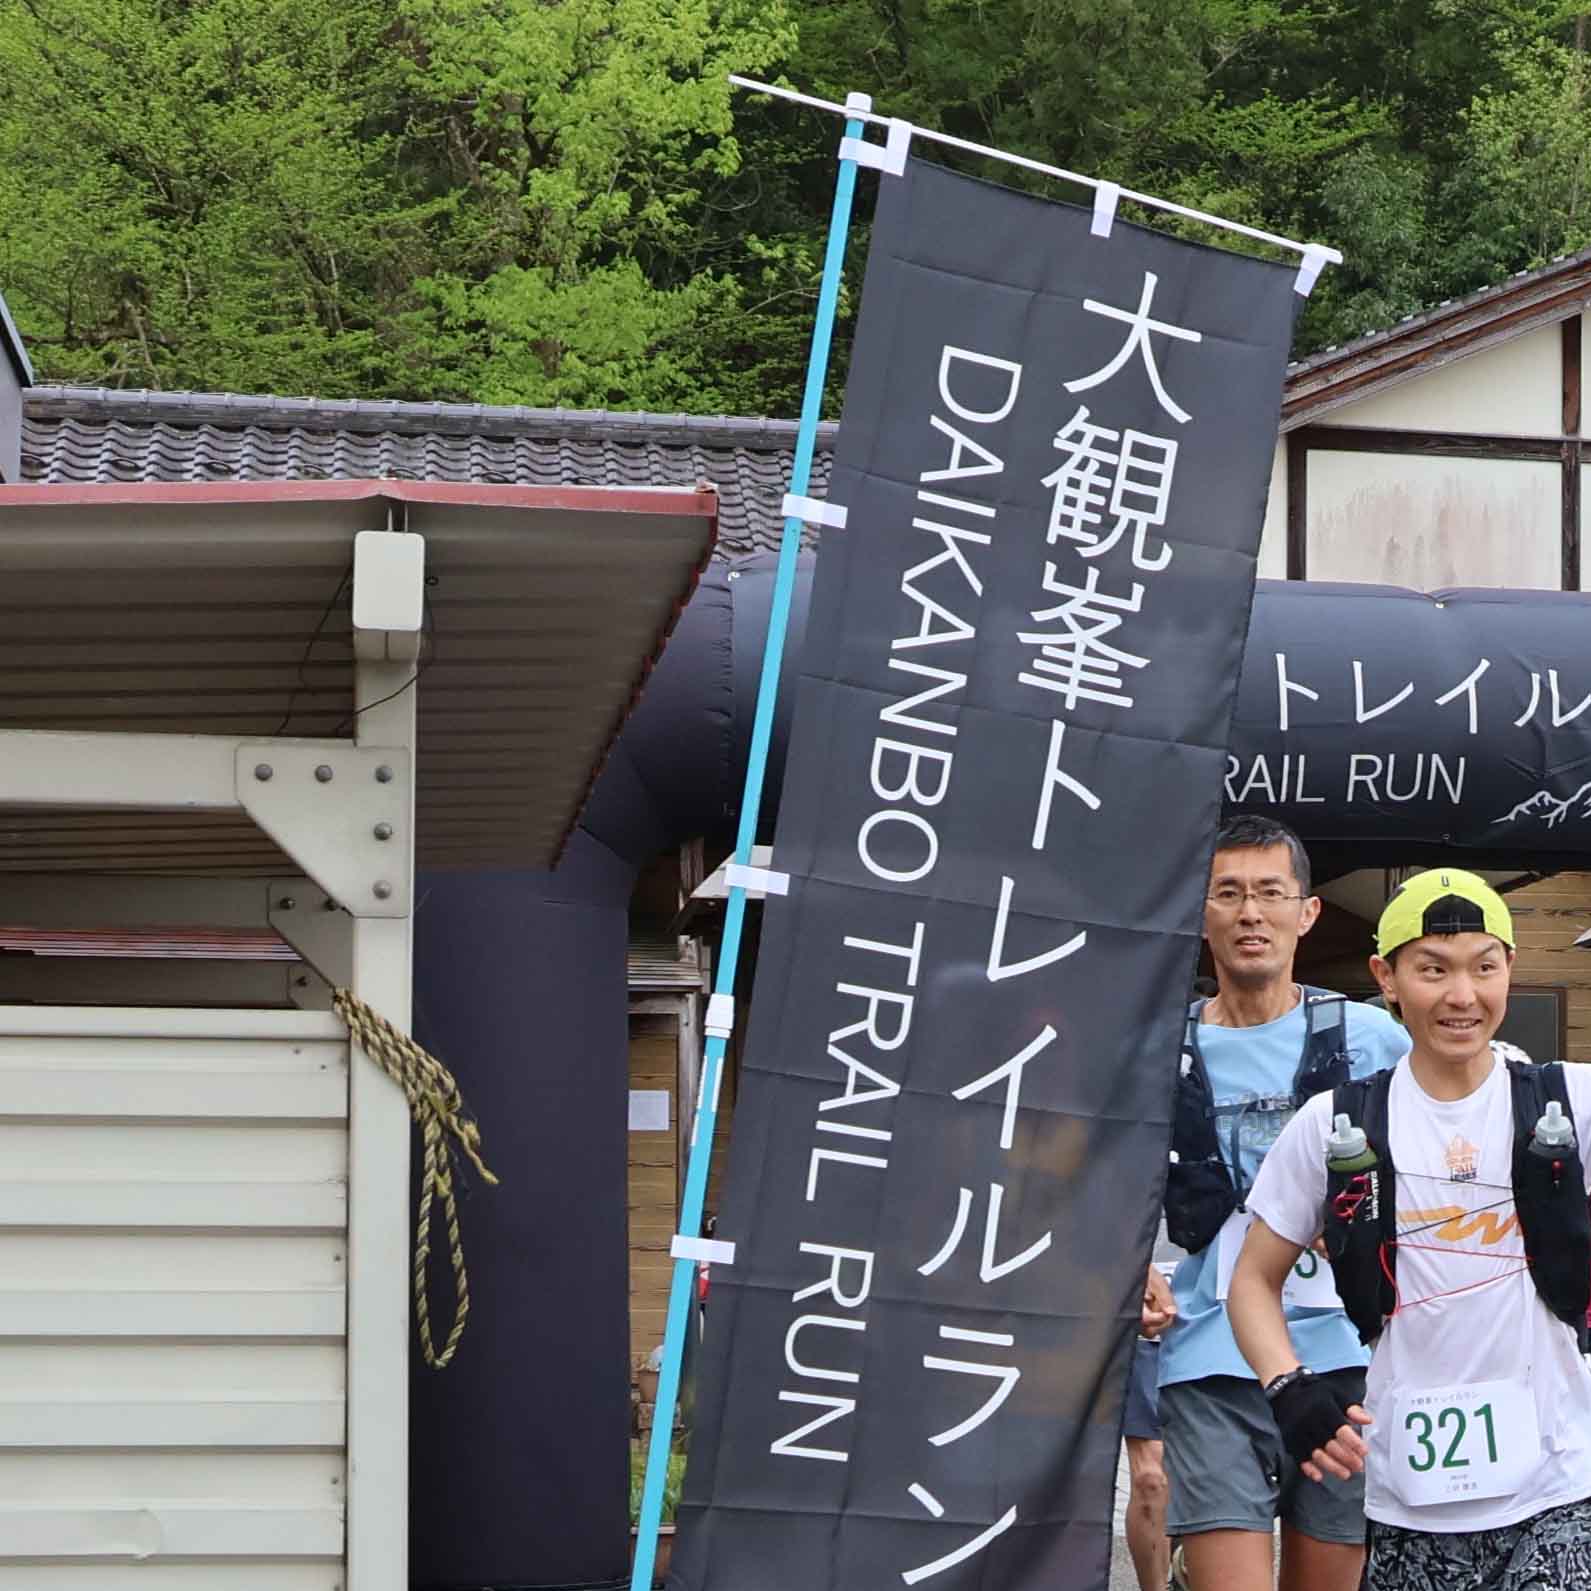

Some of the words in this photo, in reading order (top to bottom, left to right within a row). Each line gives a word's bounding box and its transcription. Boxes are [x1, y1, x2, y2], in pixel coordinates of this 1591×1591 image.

[857, 345, 1022, 882] DAIKANBO
[1346, 752, 1466, 805] RUN
[902, 271, 1202, 1585] 大観峯トレイルラン
[807, 921, 925, 1202] TRAIL
[771, 1241, 874, 1462] RUN
[1404, 1403, 1499, 1472] 321
